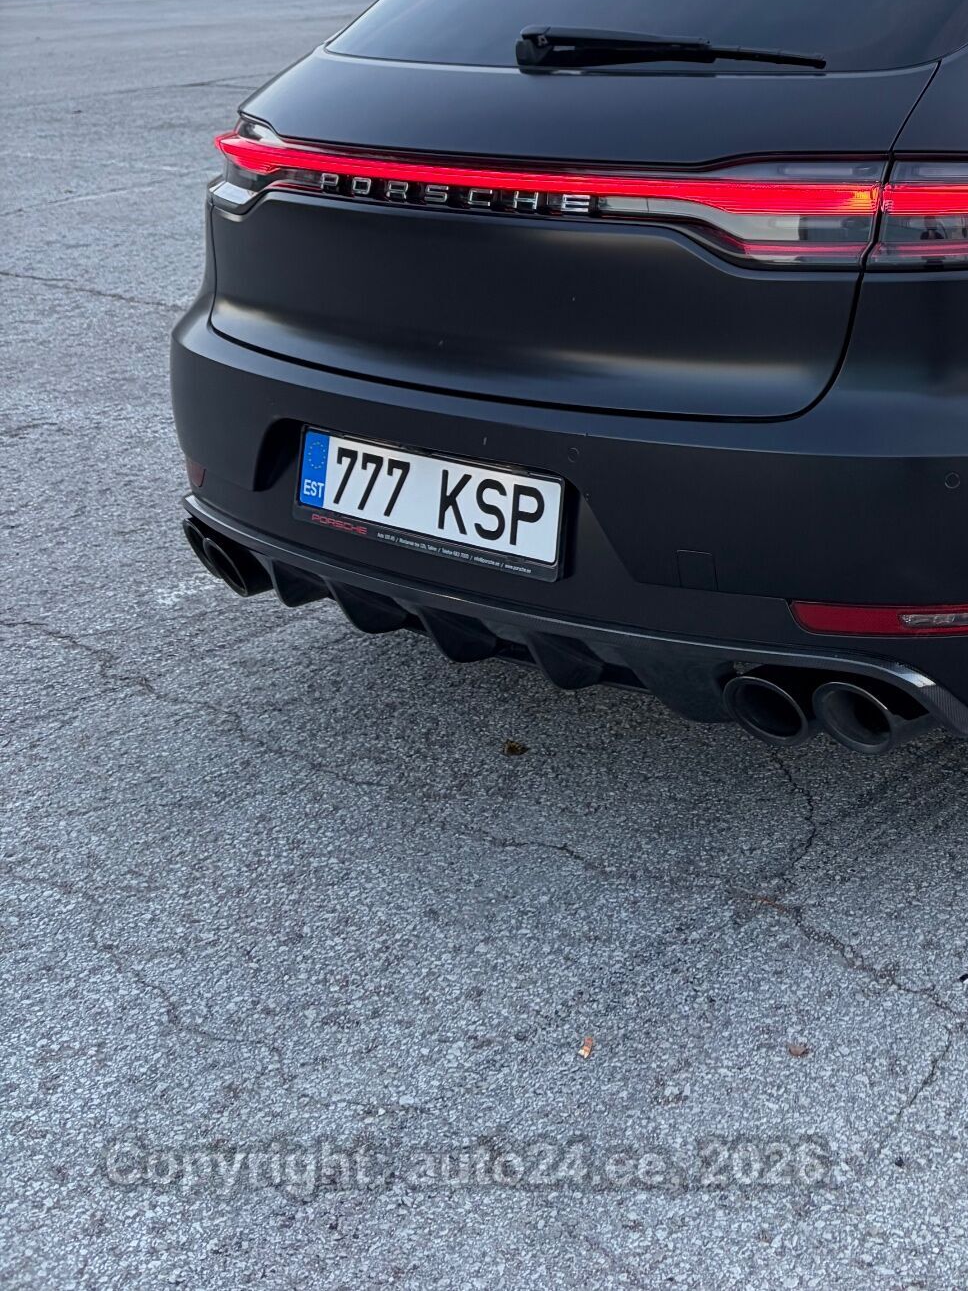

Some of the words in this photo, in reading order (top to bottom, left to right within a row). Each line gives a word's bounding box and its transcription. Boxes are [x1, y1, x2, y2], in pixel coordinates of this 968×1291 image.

[320, 173, 591, 213] PORSCHE
[303, 478, 325, 499] EST
[333, 447, 411, 517] 777
[437, 469, 545, 546] KSP
[311, 513, 368, 535] PORSCHE
